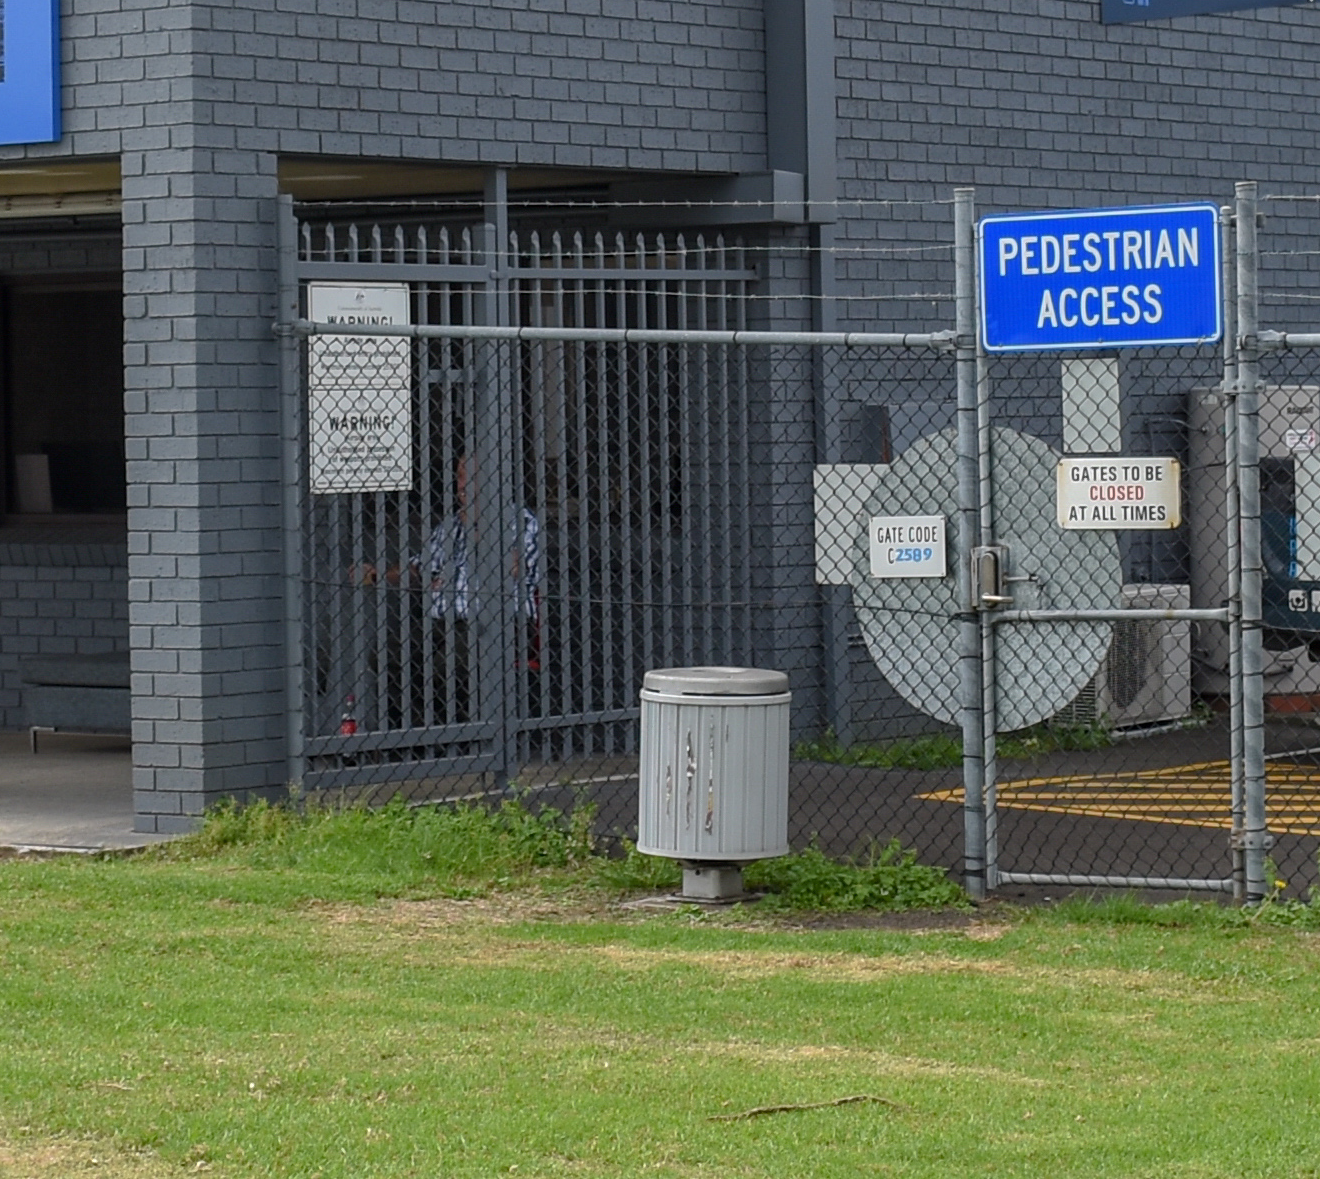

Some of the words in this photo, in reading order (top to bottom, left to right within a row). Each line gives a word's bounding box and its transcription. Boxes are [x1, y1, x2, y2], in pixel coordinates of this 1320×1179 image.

[998, 227, 1199, 277] PEDESTRIAN
[1037, 283, 1163, 329] ACCESS
[328, 415, 396, 430] WARNING!
[1071, 466, 1118, 482] GATES
[1122, 466, 1140, 481] TO
[1145, 466, 1163, 481] BE
[1090, 485, 1145, 501] CLOSED
[1068, 506, 1087, 521] AT
[1092, 505, 1118, 521] ALL
[1121, 505, 1167, 521] TIMES
[877, 527, 904, 544] GATE
[908, 526, 938, 543] CODE
[887, 547, 933, 565] C2589
